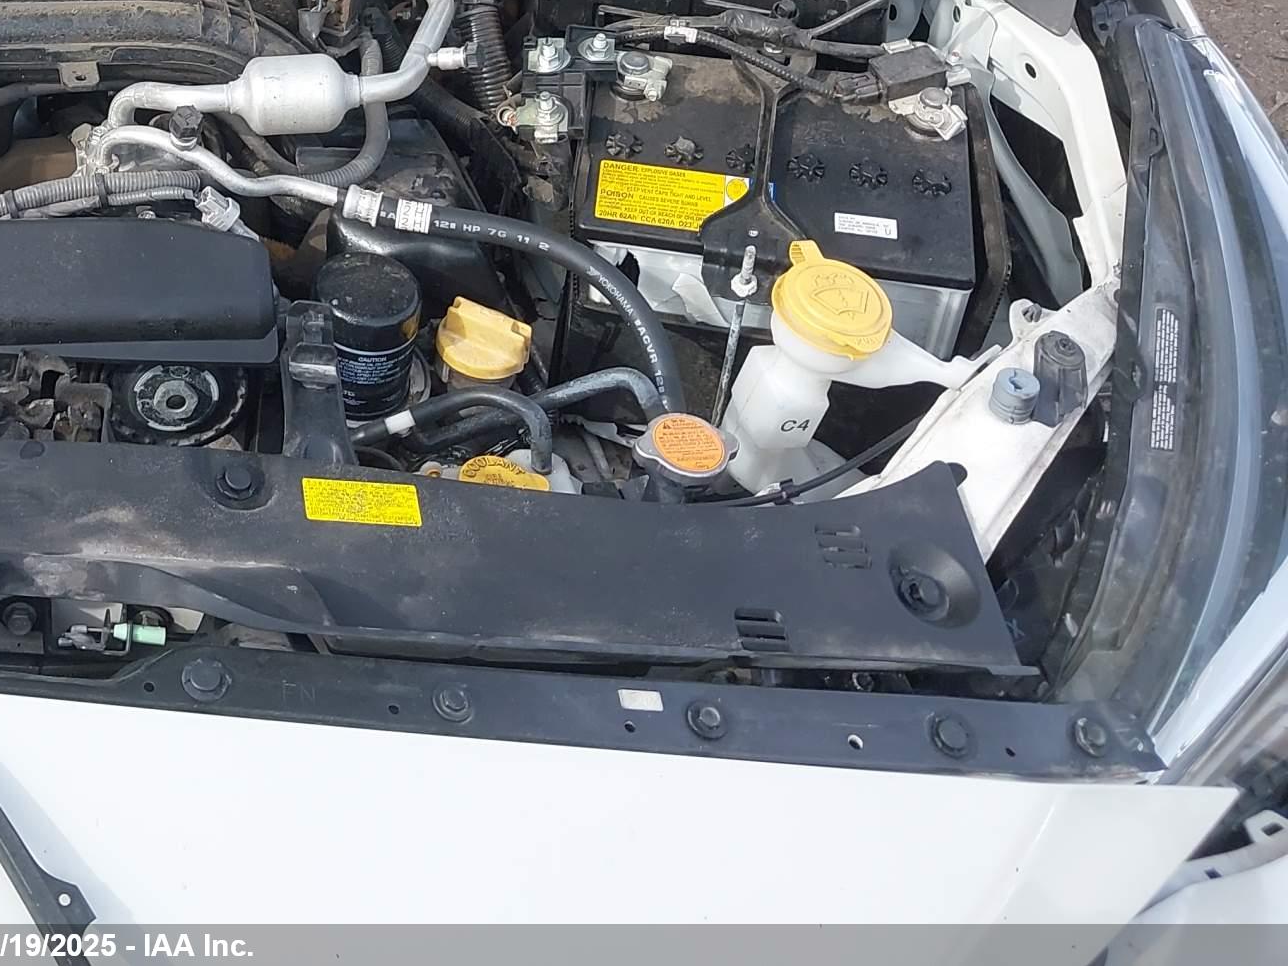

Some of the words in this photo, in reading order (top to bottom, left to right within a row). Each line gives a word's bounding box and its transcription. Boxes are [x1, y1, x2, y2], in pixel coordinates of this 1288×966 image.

[640, 215, 657, 224] CCA
[462, 223, 481, 233] HP
[597, 275, 635, 316] YOKOHAMA
[780, 419, 810, 432] C4
[462, 457, 526, 478] COOLANT
